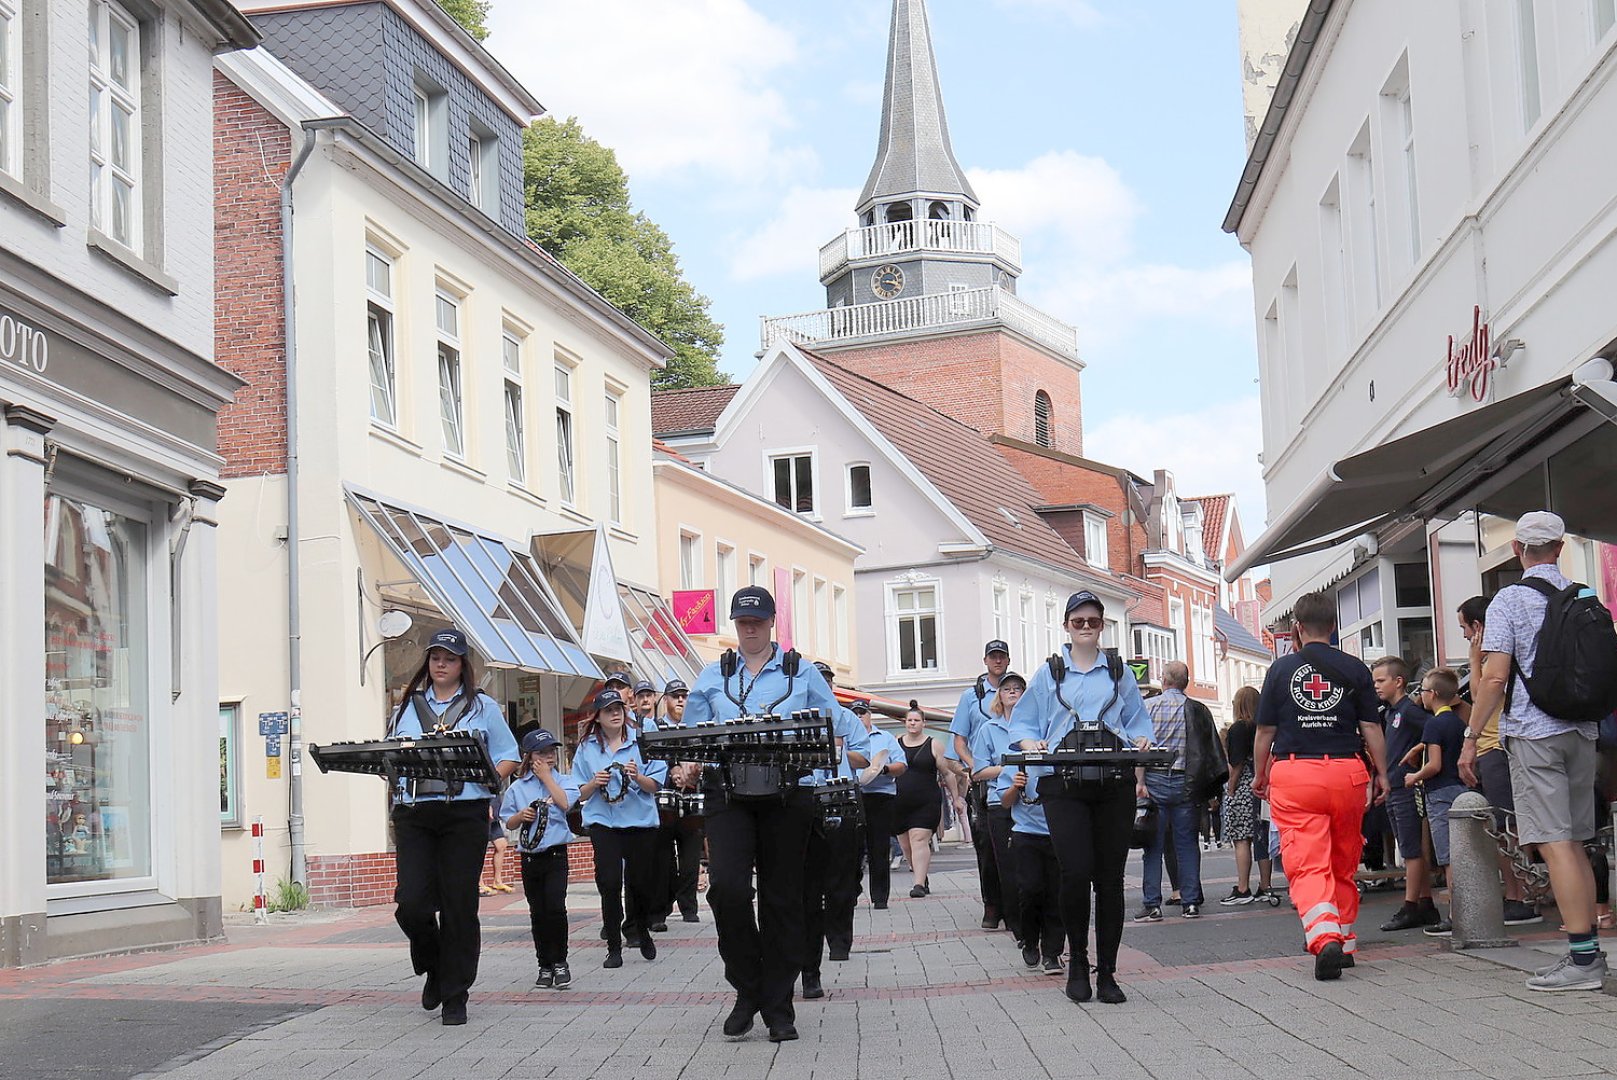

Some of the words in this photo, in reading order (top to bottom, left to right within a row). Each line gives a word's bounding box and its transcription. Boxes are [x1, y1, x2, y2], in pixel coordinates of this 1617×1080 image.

[0, 315, 49, 373] OTO
[1294, 665, 1317, 682] DEUT
[1293, 686, 1317, 709] ROTES
[1317, 687, 1341, 709] KREUZ
[1297, 714, 1338, 722] Kreisverband
